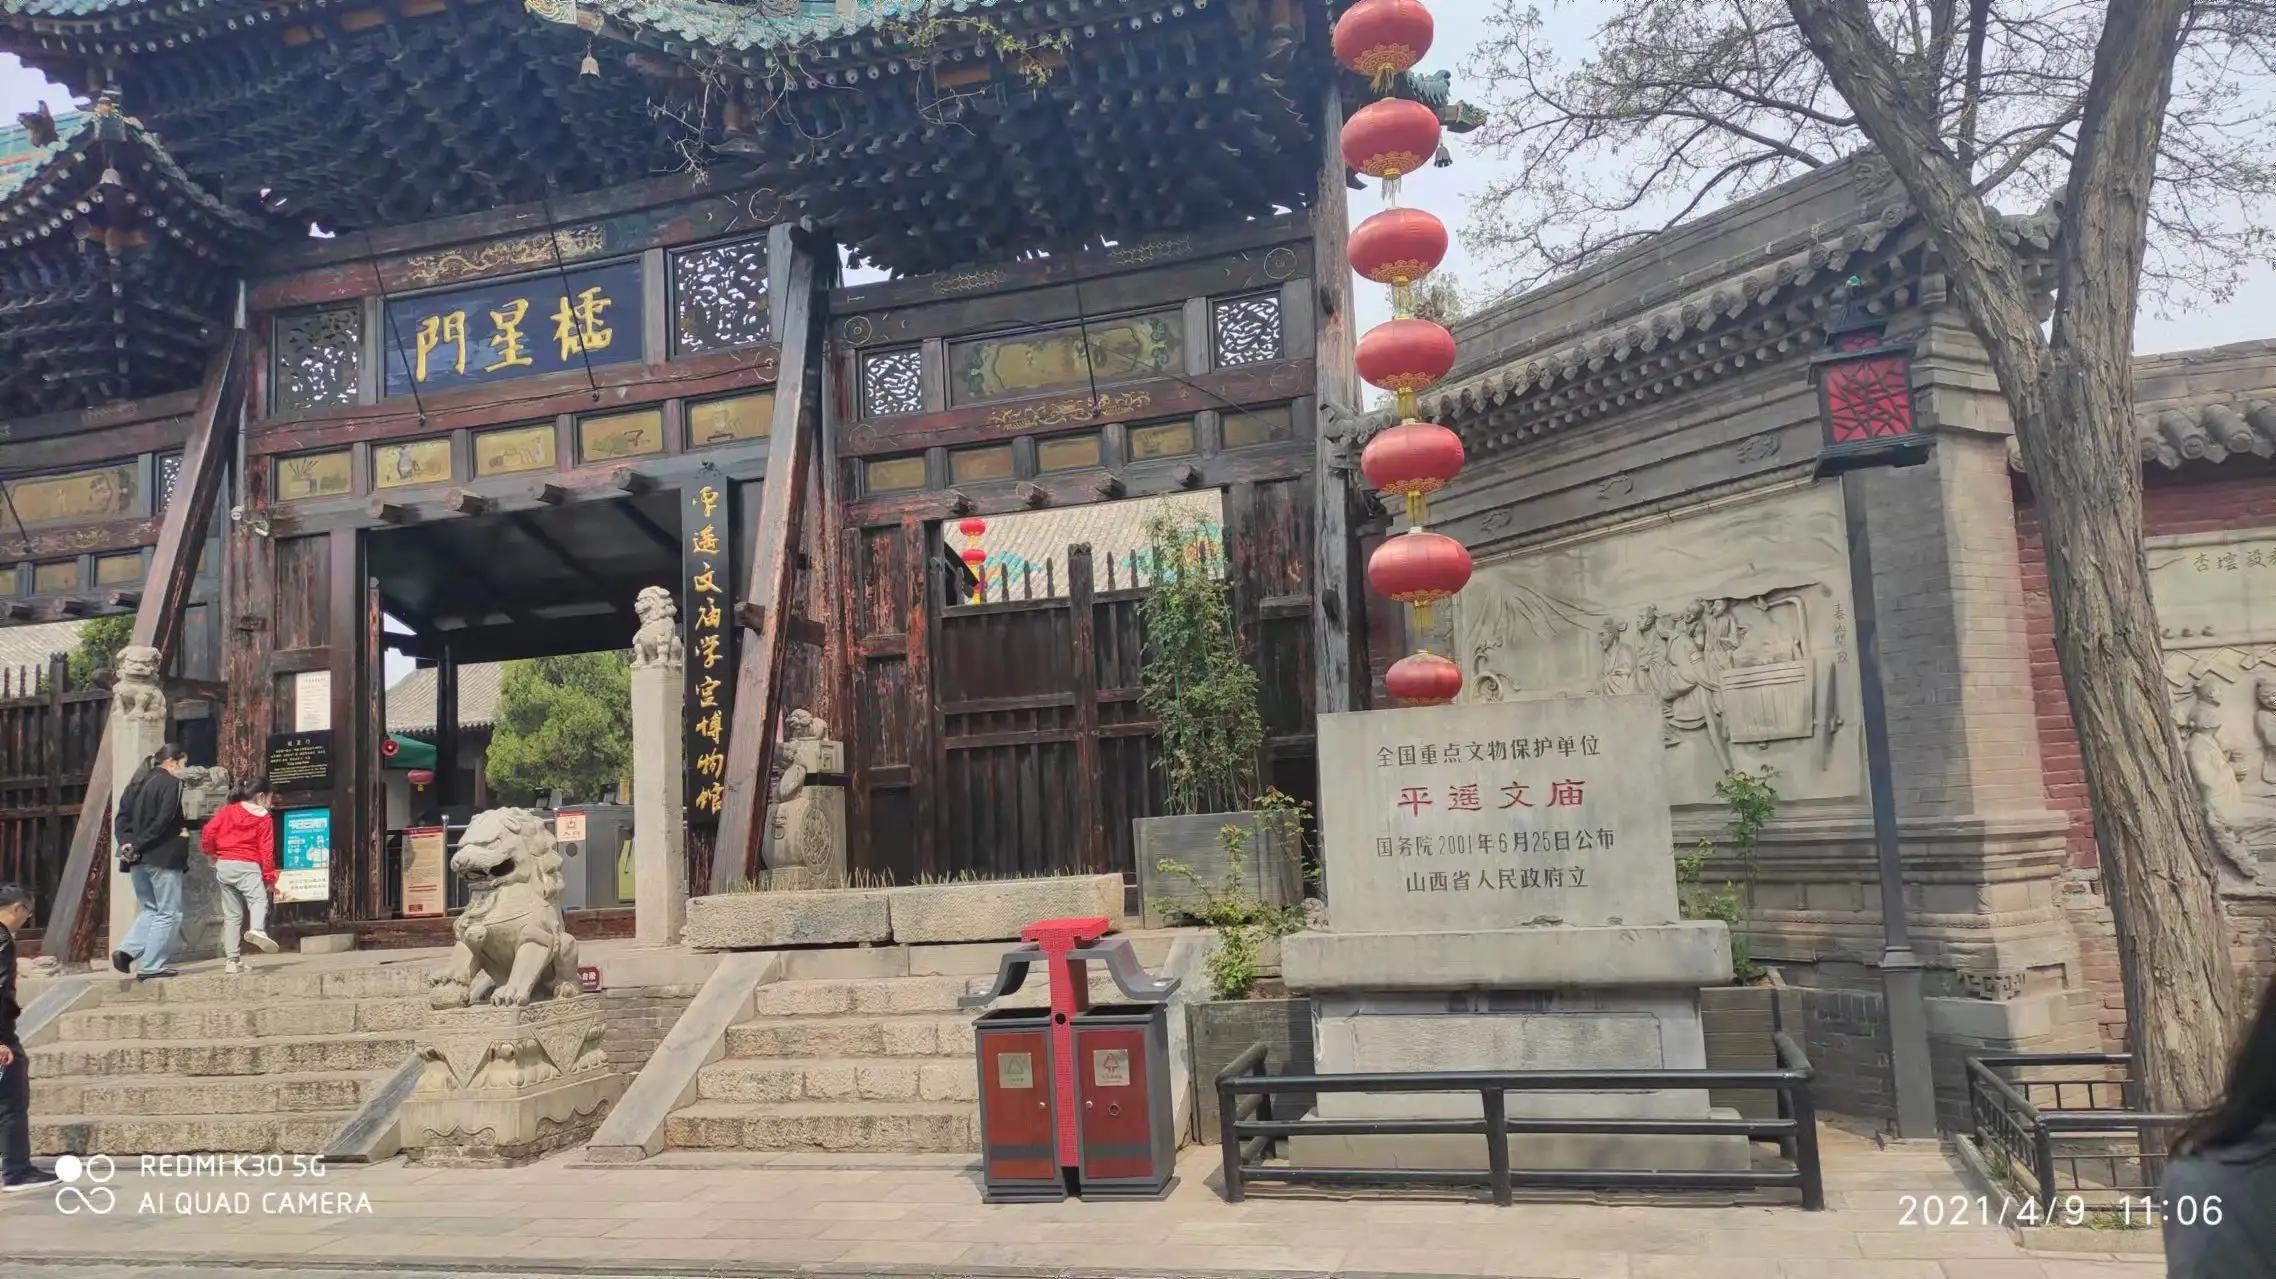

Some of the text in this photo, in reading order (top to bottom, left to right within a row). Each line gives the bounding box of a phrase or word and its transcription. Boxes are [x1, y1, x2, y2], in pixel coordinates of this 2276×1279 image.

[1376, 735, 1601, 768] 全国重点文物保护单位
[1397, 779, 1587, 817] 平遥文庙
[1376, 828, 1617, 857] 国务院2001年6月25日公布
[1406, 865, 1589, 893] 山西省人民政府立
